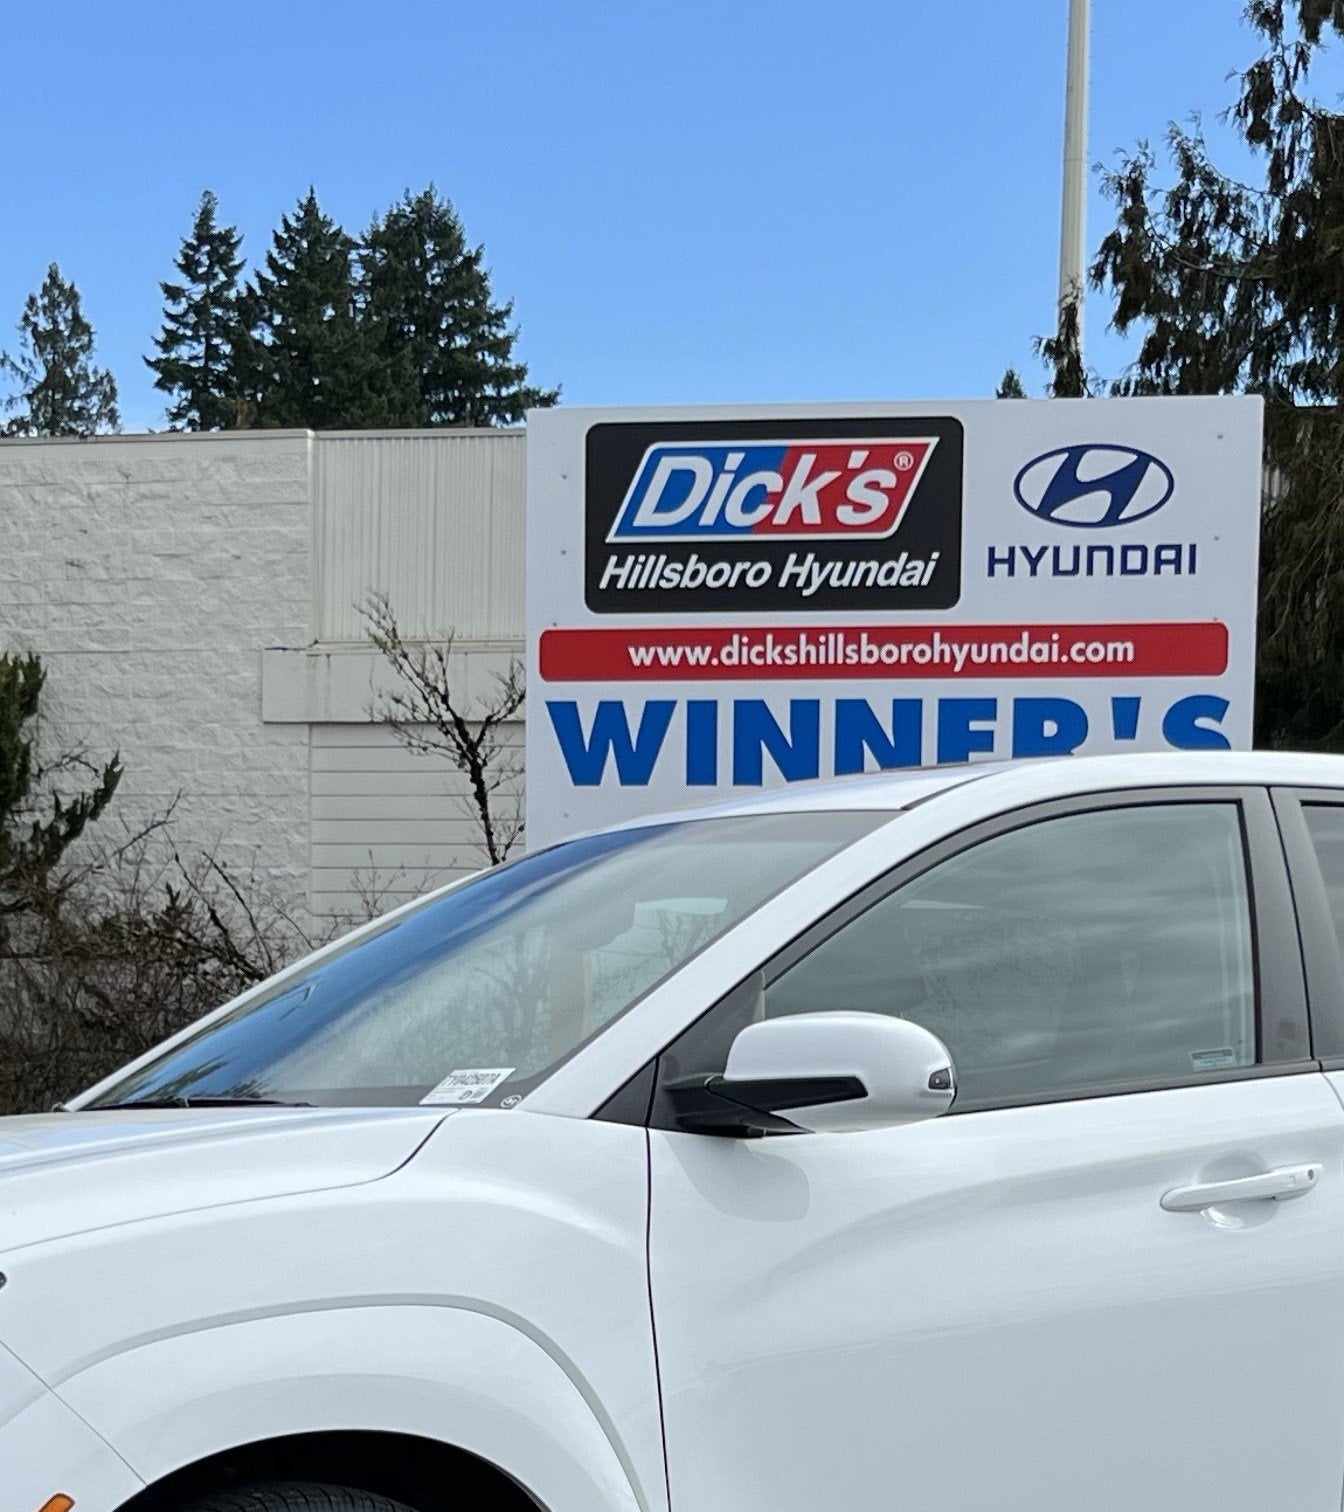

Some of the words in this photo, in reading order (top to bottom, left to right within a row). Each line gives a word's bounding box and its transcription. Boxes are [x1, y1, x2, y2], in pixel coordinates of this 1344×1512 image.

[599, 555, 772, 590] Hillsboro
[778, 551, 939, 597] Hyundai
[987, 543, 1198, 578] HYUNDAI
[628, 633, 1135, 673] www.dickshillsborohyundai.com
